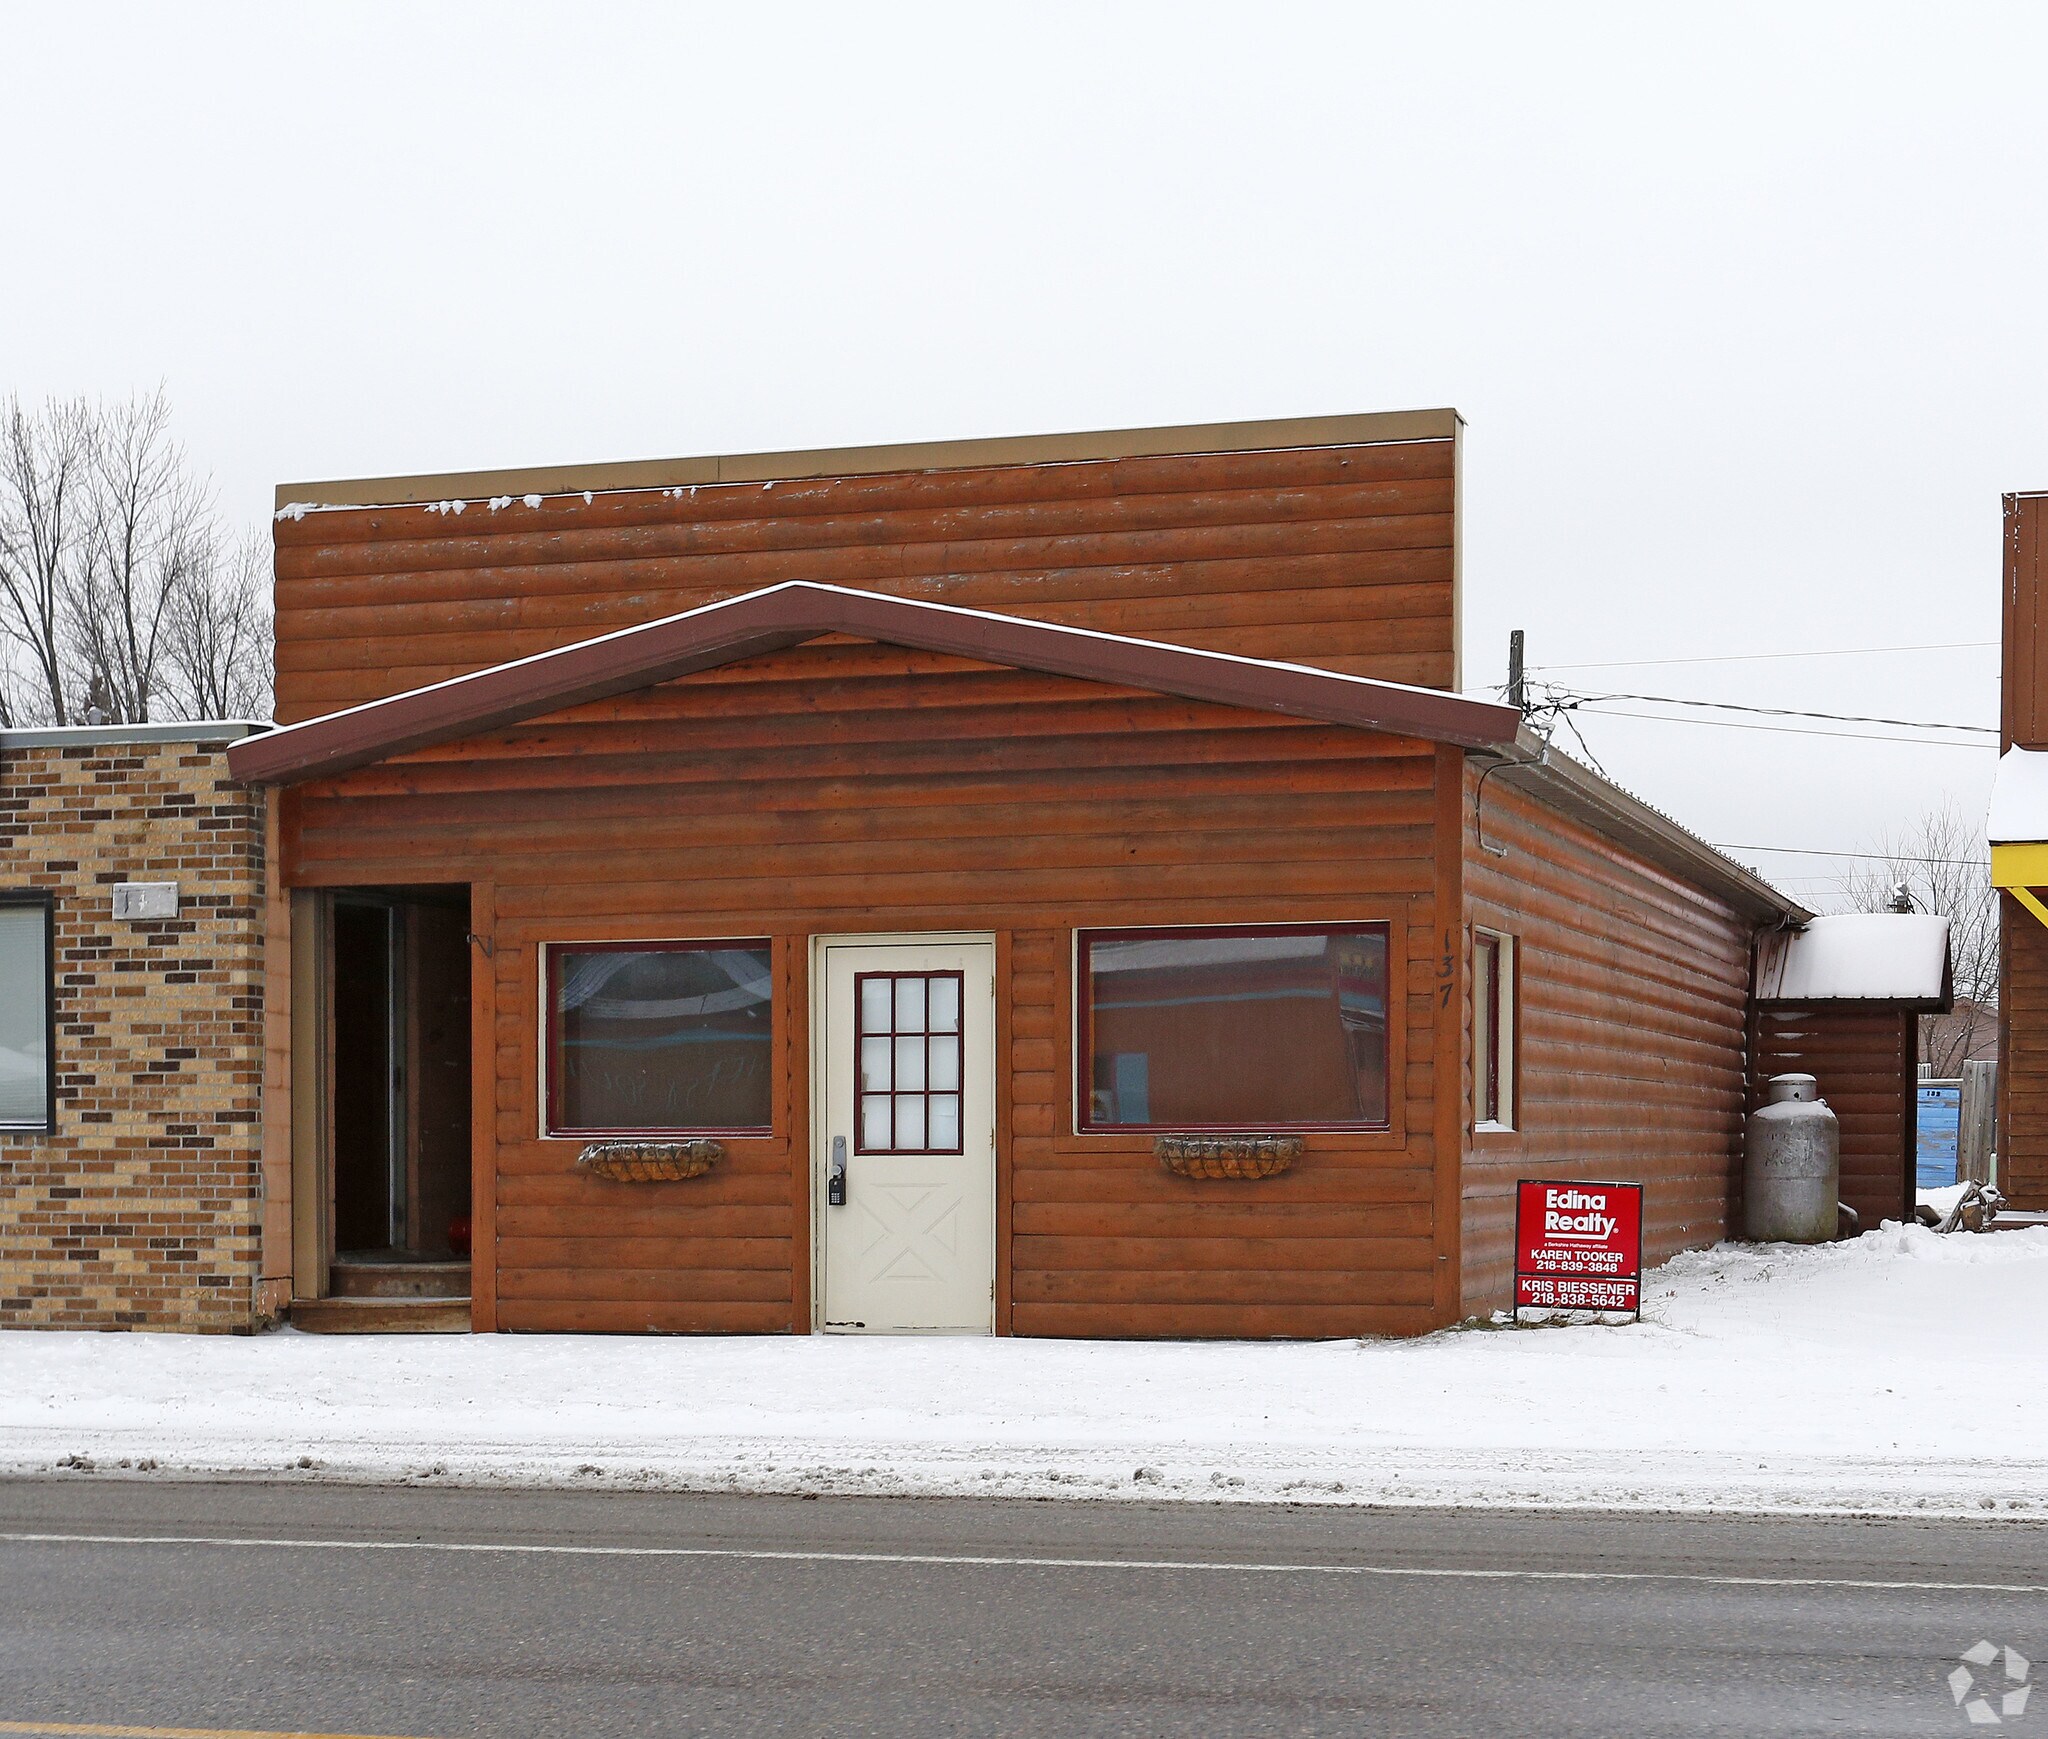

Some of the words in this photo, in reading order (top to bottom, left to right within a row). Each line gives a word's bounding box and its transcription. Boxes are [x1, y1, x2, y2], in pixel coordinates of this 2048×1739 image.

[1436, 928, 1455, 1009] 137
[1545, 1189, 1606, 1211] Edina
[1531, 1249, 1572, 1261] KAREN
[1574, 1251, 1624, 1263] TOOKER
[1536, 1260, 1618, 1273] 218-839-3848
[1522, 1280, 1554, 1293] KRIS
[1557, 1282, 1636, 1296] BIESSENER
[1532, 1292, 1625, 1307] 218-838-5642
